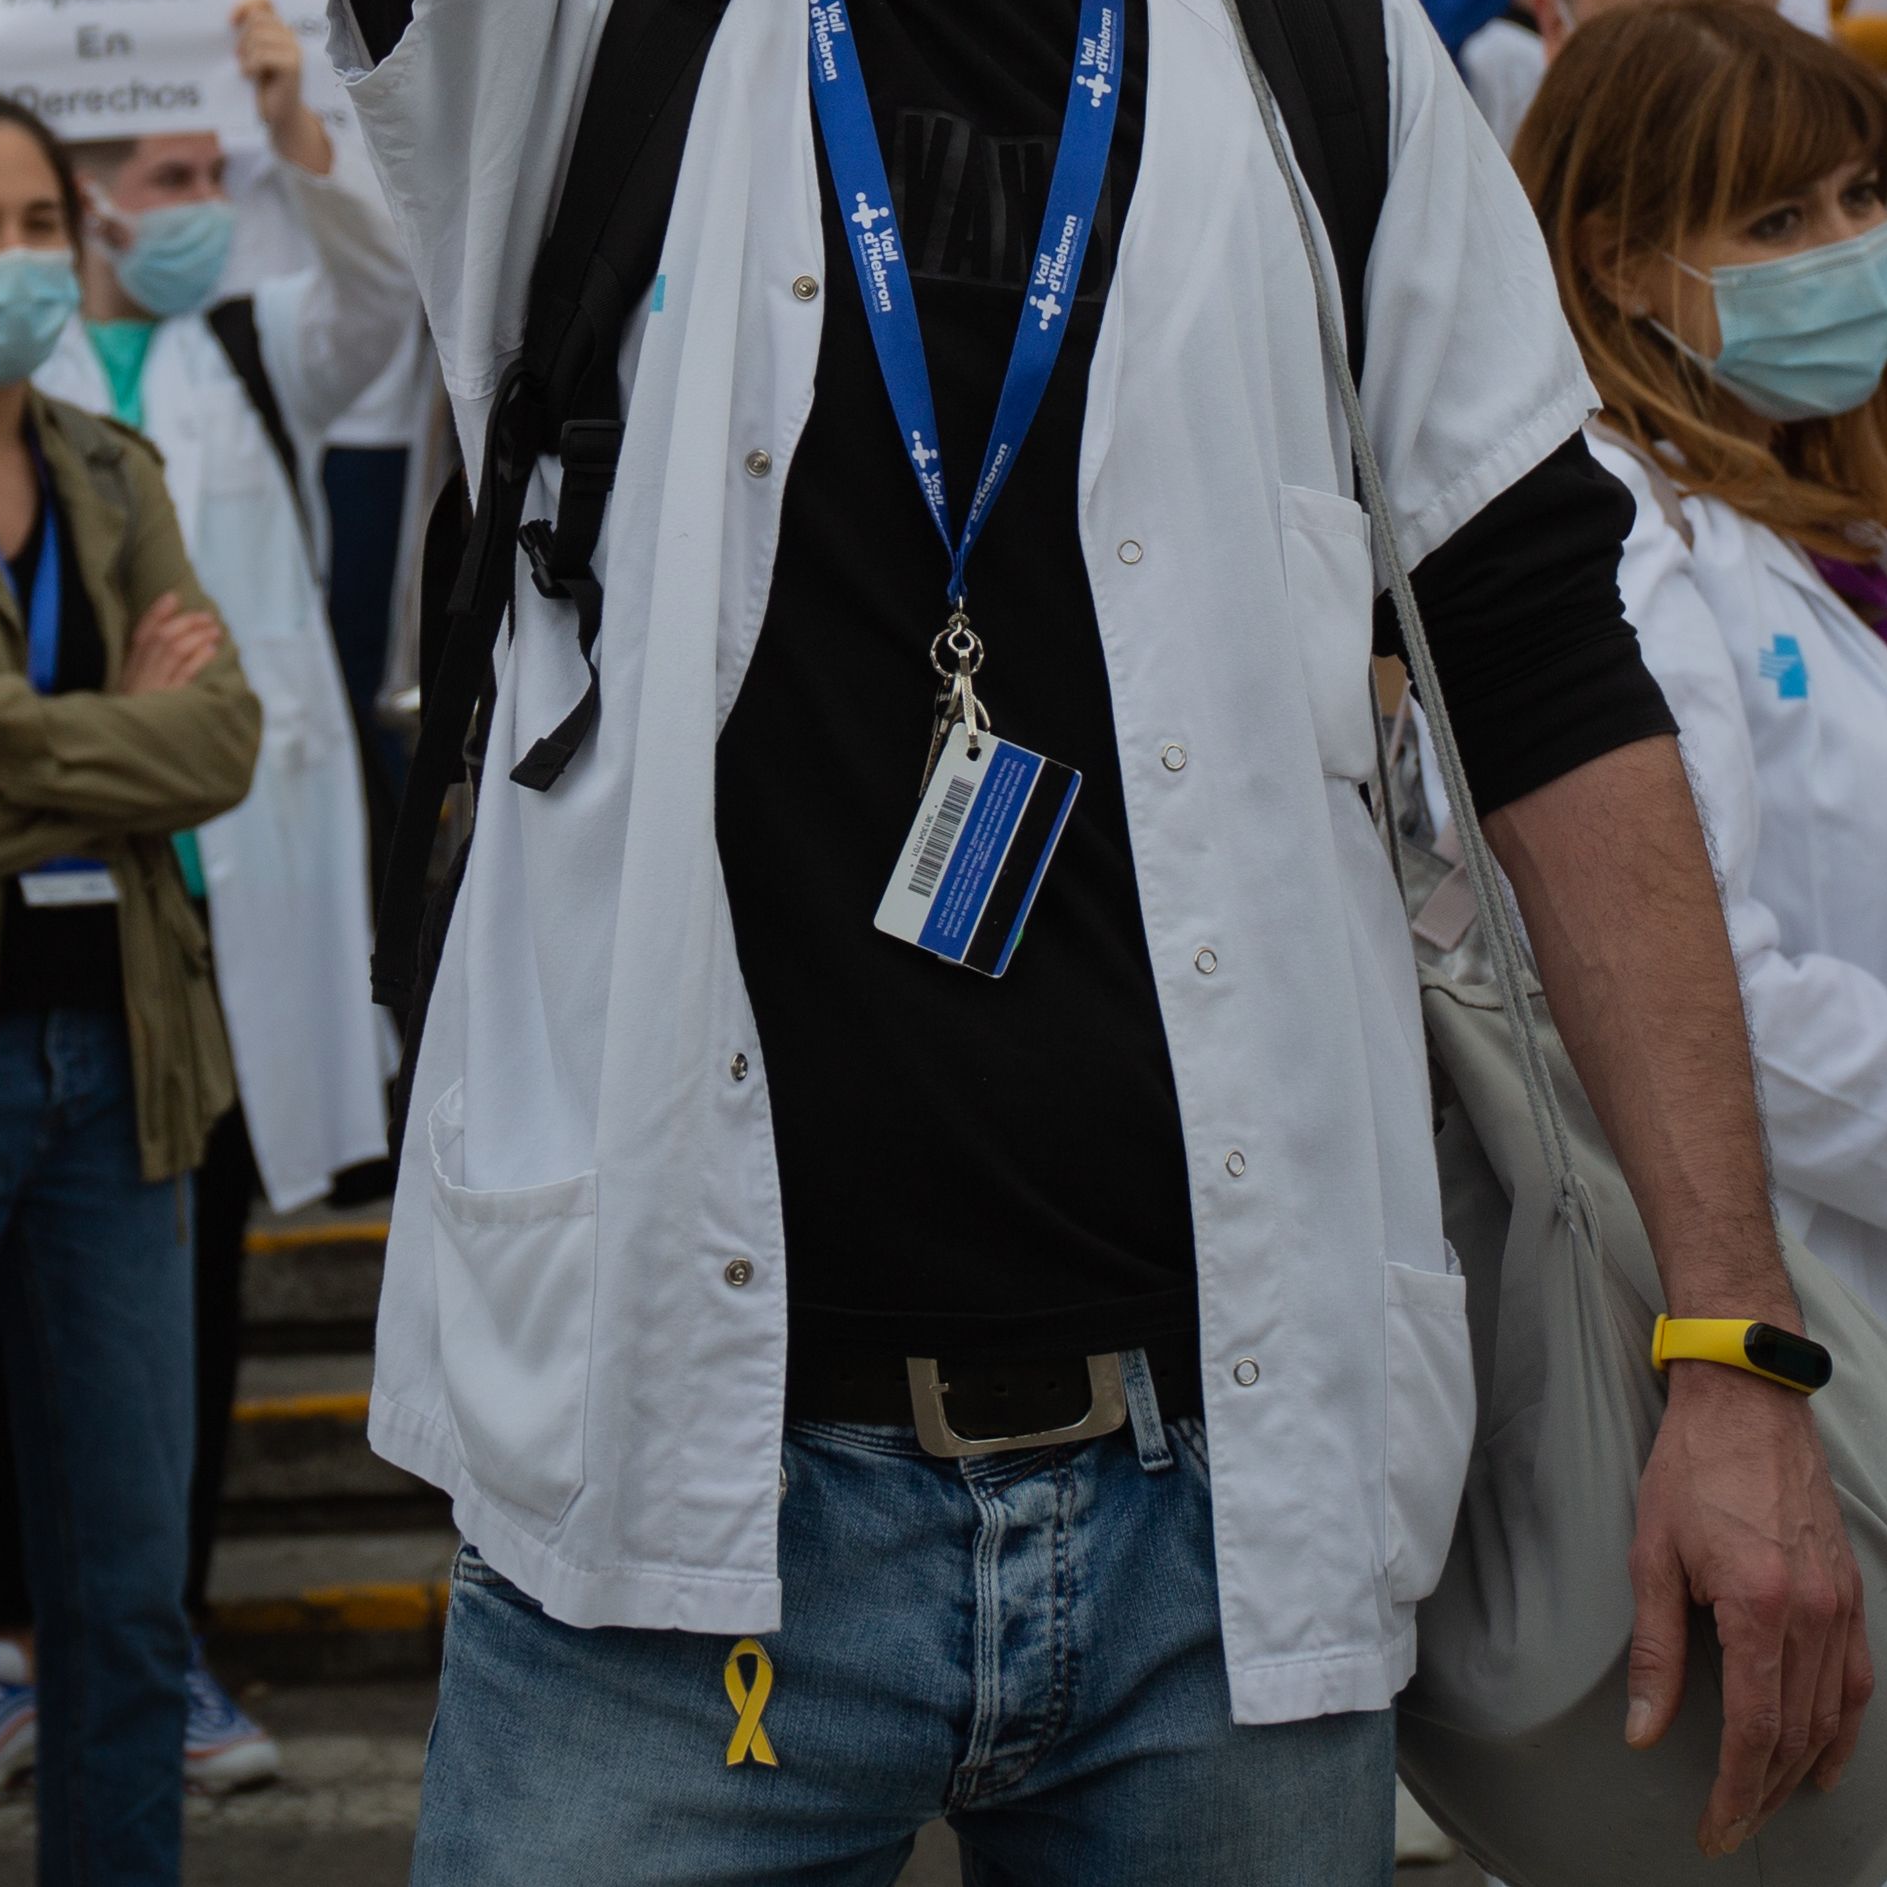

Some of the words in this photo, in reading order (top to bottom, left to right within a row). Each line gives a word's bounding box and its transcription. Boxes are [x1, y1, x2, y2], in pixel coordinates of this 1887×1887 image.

[824, 1, 846, 33] Vall
[77, 26, 134, 58] En
[1081, 37, 1097, 68] Vall
[14, 80, 201, 115] Derechos
[878, 227, 899, 262] Vall
[1035, 253, 1052, 286] Vall
